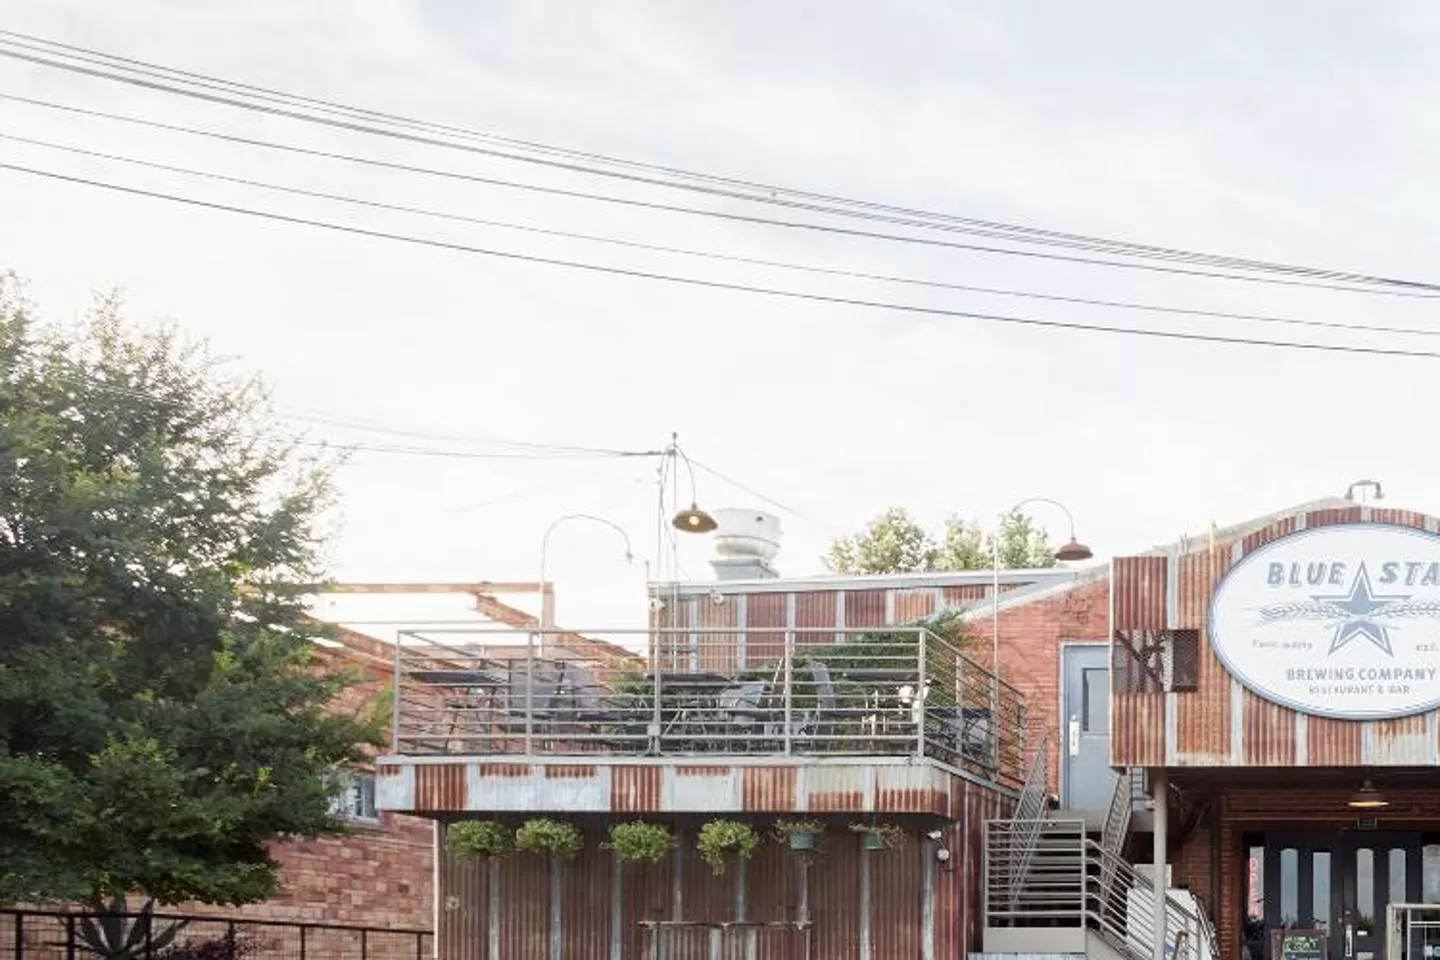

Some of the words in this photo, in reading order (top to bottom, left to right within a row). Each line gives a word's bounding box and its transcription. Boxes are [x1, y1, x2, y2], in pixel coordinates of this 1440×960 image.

[1266, 561, 1346, 587] BLUE
[1287, 667, 1355, 681] BREWING
[1358, 667, 1437, 681] COMPANY
